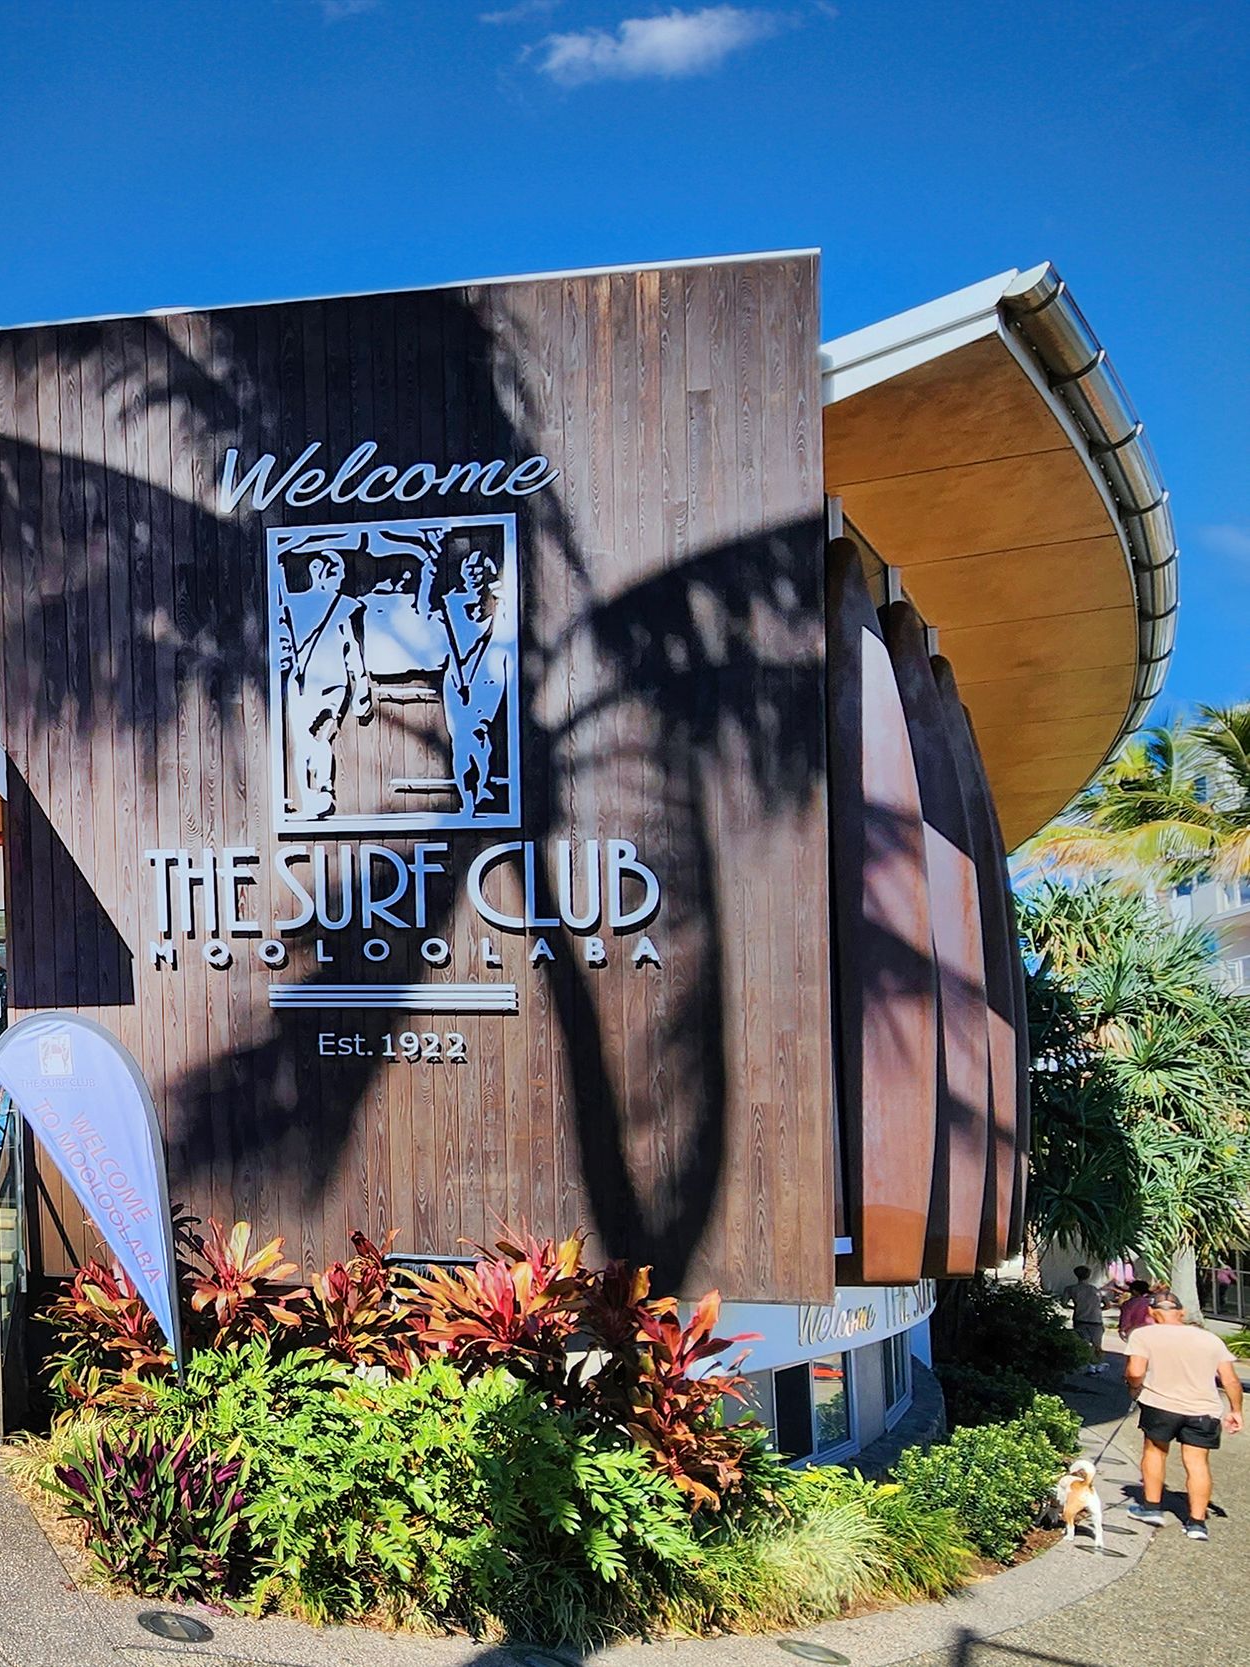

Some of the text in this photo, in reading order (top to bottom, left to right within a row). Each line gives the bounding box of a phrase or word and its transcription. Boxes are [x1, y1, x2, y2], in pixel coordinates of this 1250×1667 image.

[217, 441, 558, 514] Welcome
[145, 838, 661, 934] THE SURF CLUB
[149, 937, 661, 965] MOOLOOLABA
[318, 1033, 467, 1059] Est. 1922
[31, 1097, 60, 1130] TO
[55, 1132, 164, 1284] MOOLOOLABA
[70, 1111, 154, 1224] WELCOME
[798, 1292, 877, 1347] Welcome
